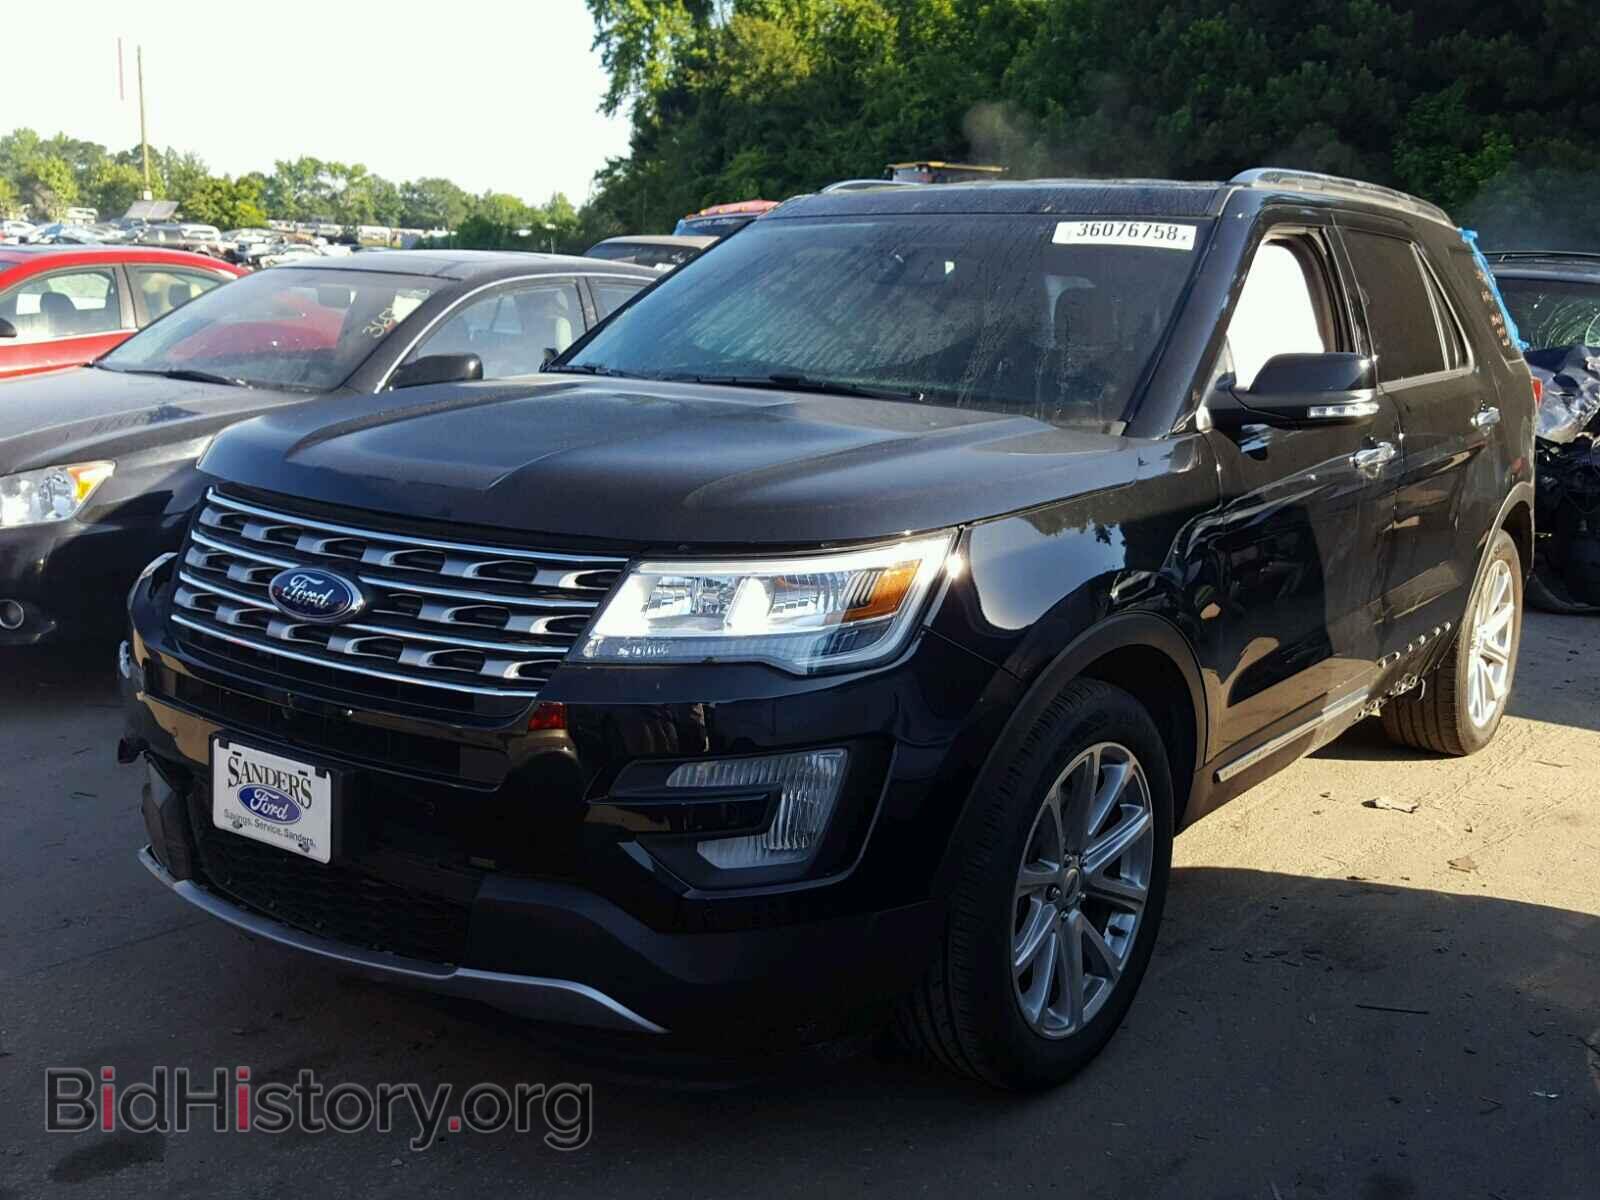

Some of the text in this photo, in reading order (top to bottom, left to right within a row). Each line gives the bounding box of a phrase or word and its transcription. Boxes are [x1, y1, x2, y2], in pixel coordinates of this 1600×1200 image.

[282, 574, 334, 608] Ford
[227, 756, 312, 809] SANDERS
[250, 789, 289, 819] Ford
